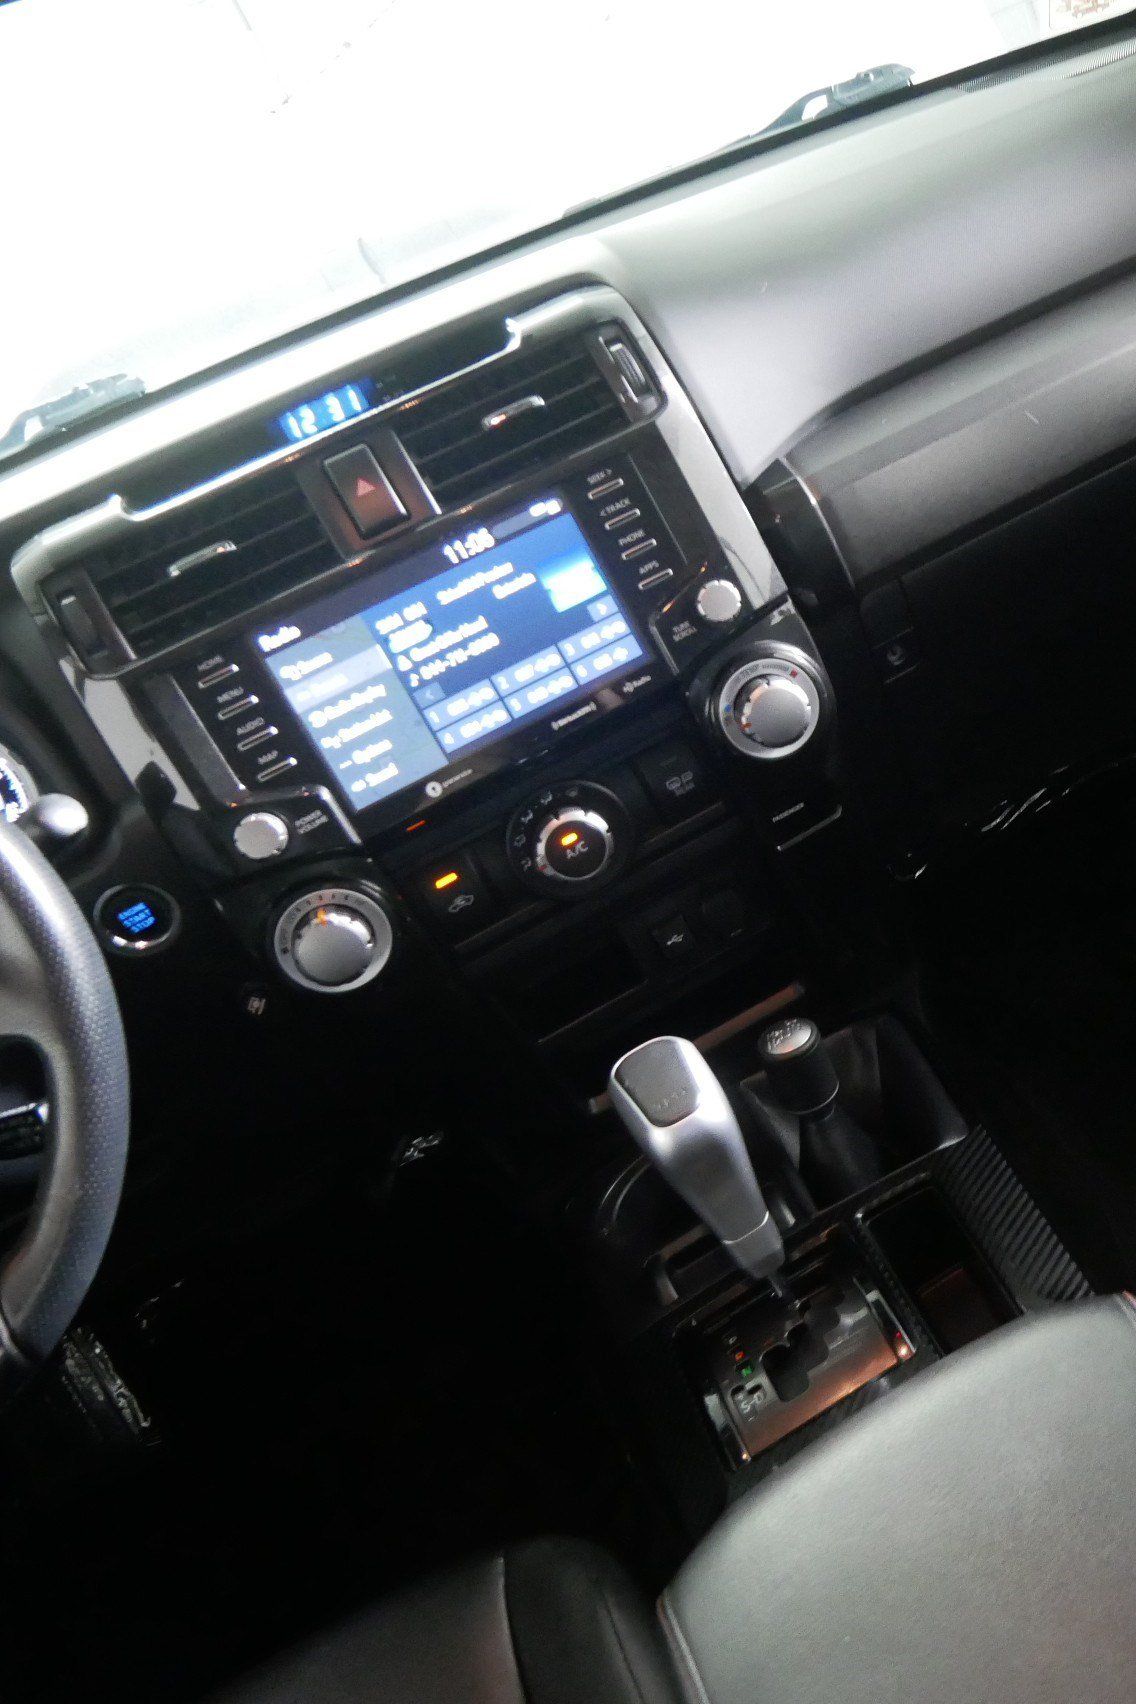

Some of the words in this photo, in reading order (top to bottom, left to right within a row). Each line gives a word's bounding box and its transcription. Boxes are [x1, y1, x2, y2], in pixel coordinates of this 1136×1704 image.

[638, 560, 659, 575] APPS
[236, 717, 264, 735] AUDIO
[566, 840, 589, 860] A/C
